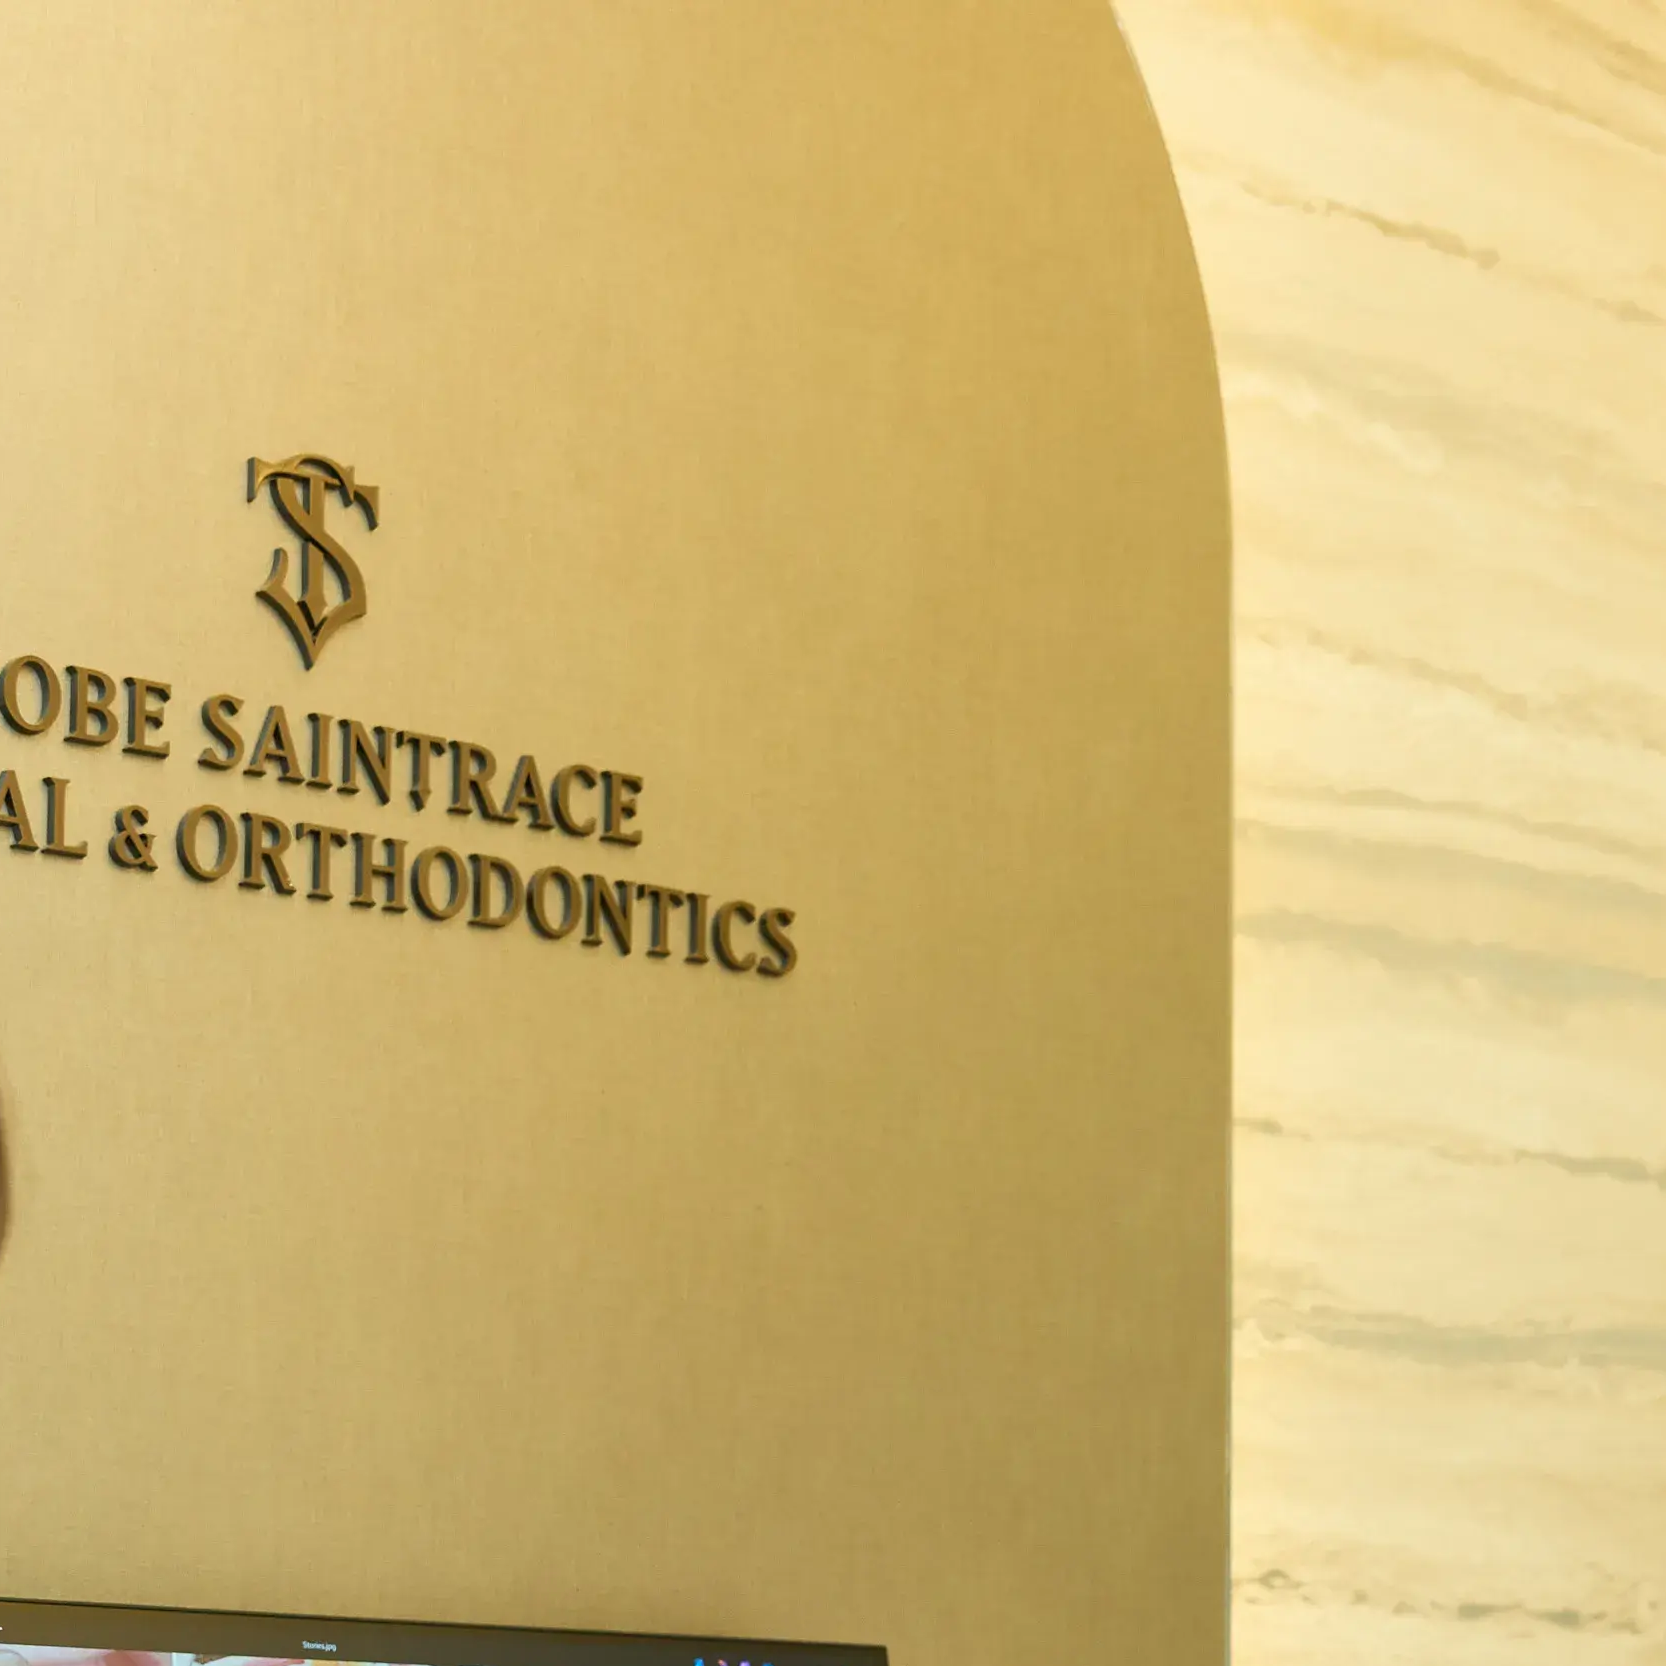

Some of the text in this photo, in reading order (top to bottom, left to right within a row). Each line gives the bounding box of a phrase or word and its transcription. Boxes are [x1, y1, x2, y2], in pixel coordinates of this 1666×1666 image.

[198, 693, 644, 847] SAINTRACE
[108, 804, 159, 872] &
[176, 804, 798, 978] ORTHODONTICS
